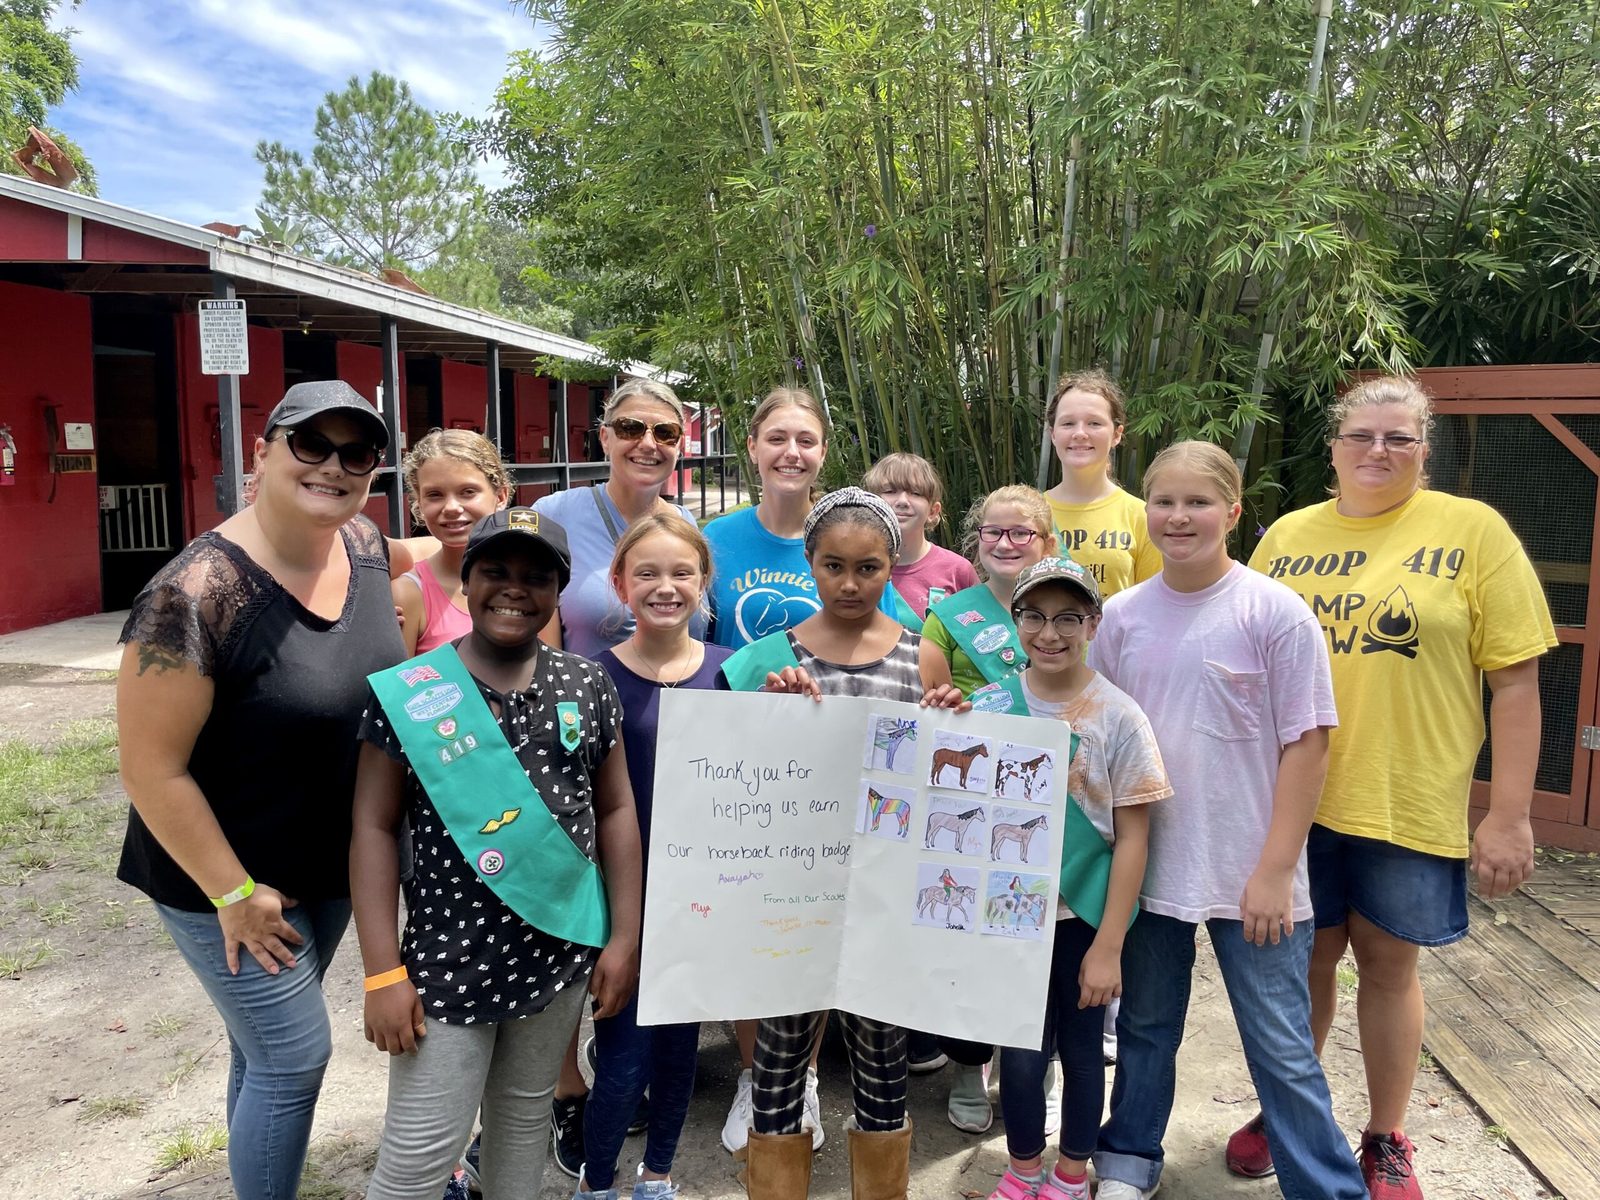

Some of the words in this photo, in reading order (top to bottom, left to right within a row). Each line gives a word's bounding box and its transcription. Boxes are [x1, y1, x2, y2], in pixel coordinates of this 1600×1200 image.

[1094, 529, 1132, 550] 419
[1402, 546, 1465, 580] 419
[730, 567, 815, 592] Winnie
[1298, 593, 1366, 621] MP
[441, 735, 476, 762] 419
[688, 757, 745, 784] Thank
[747, 767, 780, 796] you
[786, 759, 813, 779] for
[712, 797, 771, 828] helping
[781, 800, 798, 816] us
[809, 799, 839, 813] earn
[667, 843, 693, 858] Our
[708, 845, 774, 859] horseback
[779, 845, 815, 870] riding
[822, 841, 851, 864] badge
[763, 893, 785, 904] From
[789, 896, 800, 904] all
[805, 894, 819, 903] our
[822, 891, 846, 902] Scouts
